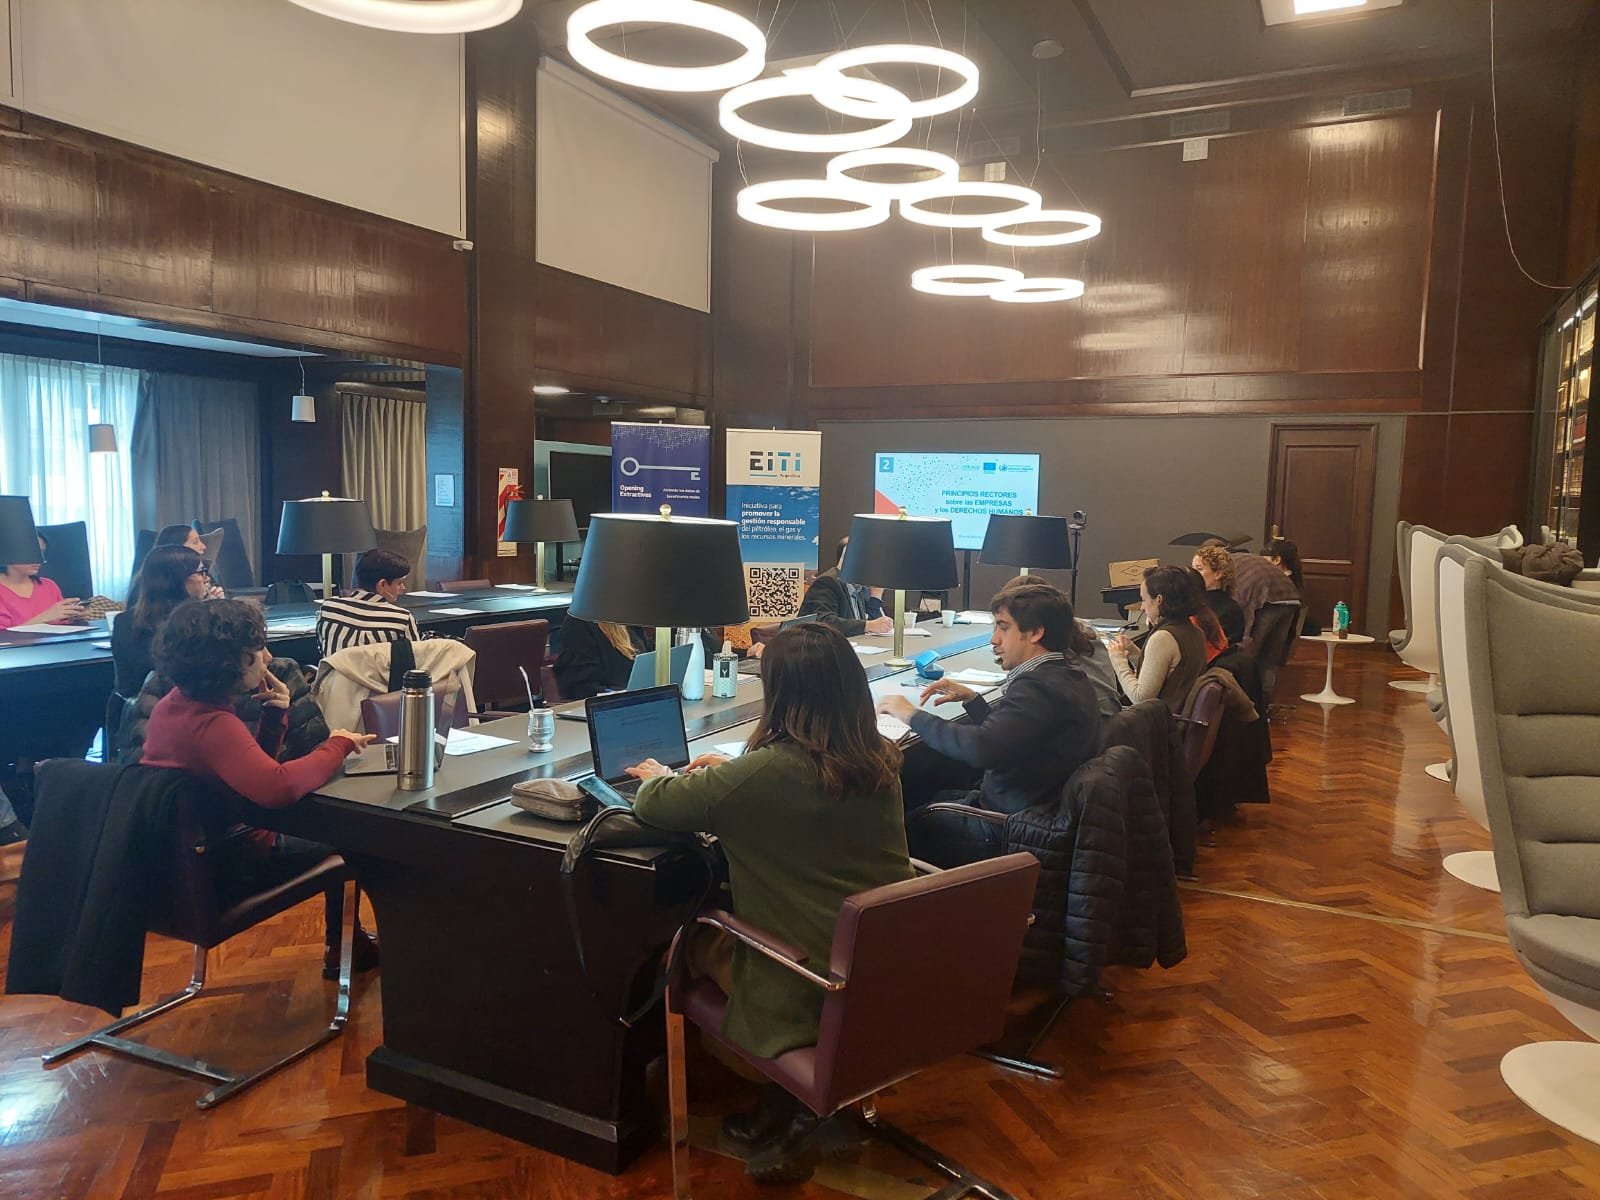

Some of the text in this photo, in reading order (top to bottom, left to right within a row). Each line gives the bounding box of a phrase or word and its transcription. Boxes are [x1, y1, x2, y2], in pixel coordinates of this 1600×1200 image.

[882, 459, 890, 470] 2
[980, 491, 1017, 499] RECTORES
[742, 501, 768, 509] Iniciativa
[950, 507, 987, 515] DERECHOS
[988, 508, 1024, 516] HUMANOS
[742, 517, 766, 526] gestión
